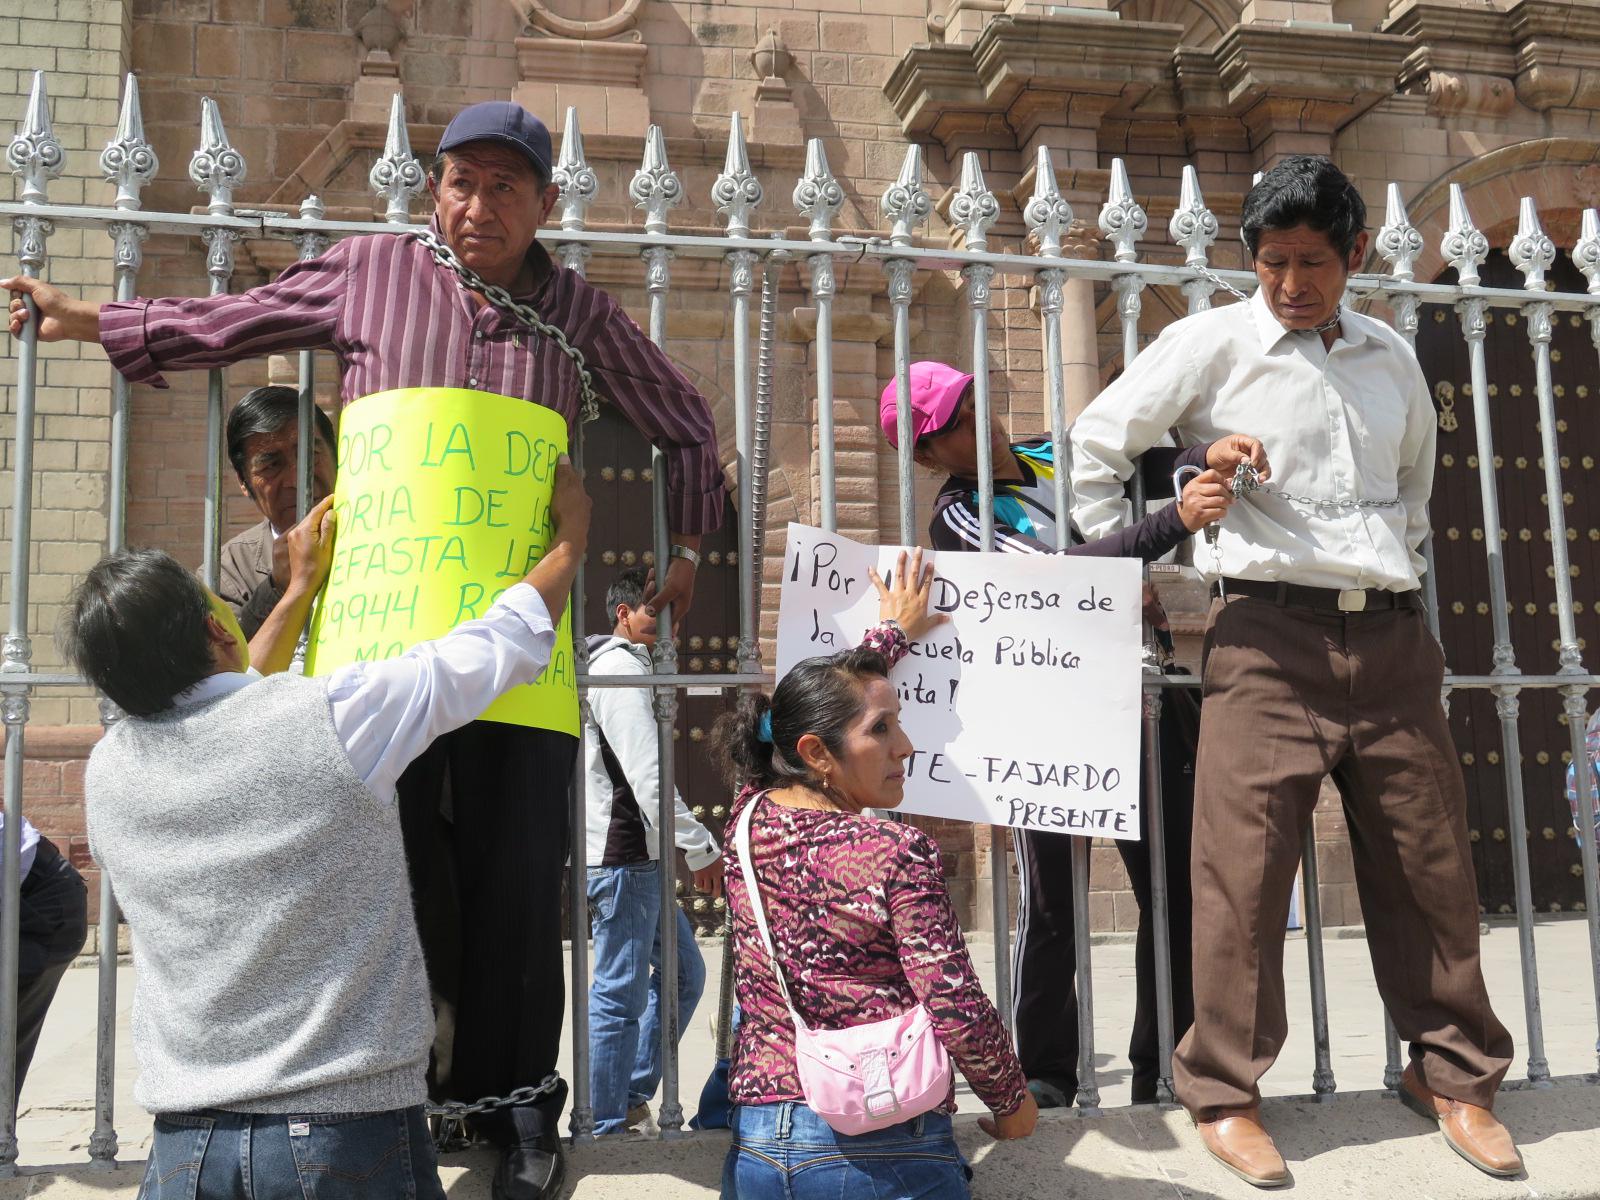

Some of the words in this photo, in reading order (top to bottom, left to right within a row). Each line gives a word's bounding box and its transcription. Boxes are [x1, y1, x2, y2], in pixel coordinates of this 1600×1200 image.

[420, 422, 476, 472] LA
[504, 430, 559, 489] DER
[336, 486, 416, 539] ORIA
[443, 486, 509, 528] DE
[529, 497, 552, 541] LA
[332, 535, 469, 587] EFASTA
[448, 583, 506, 629] R
[934, 576, 1060, 623] Defensa
[1077, 586, 1116, 612] de
[810, 608, 835, 647] la
[907, 636, 975, 665] cuela
[994, 635, 1081, 671] Pública
[906, 750, 952, 783] TE
